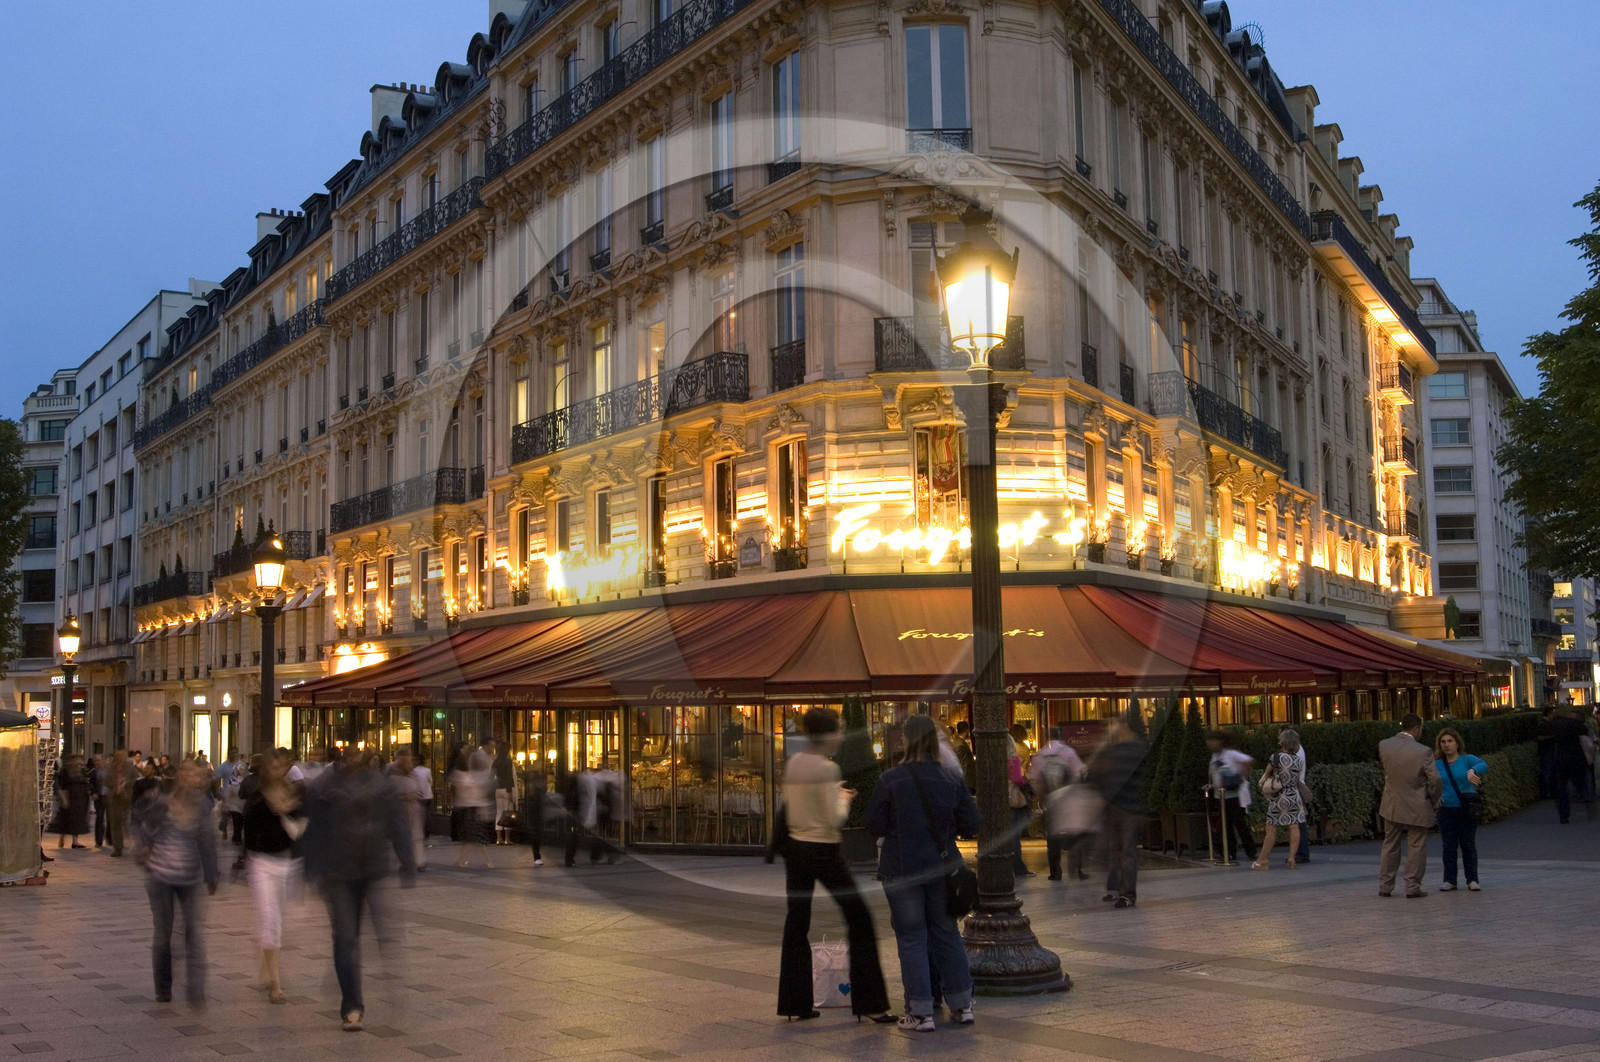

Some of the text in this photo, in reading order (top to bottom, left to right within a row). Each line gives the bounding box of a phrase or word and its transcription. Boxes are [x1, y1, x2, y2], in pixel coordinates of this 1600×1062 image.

[898, 628, 1045, 641] Fouqt's
[951, 679, 1038, 695] Foet's
[1251, 675, 1287, 692] Fouquet's
[650, 684, 725, 703] Fouquet's
